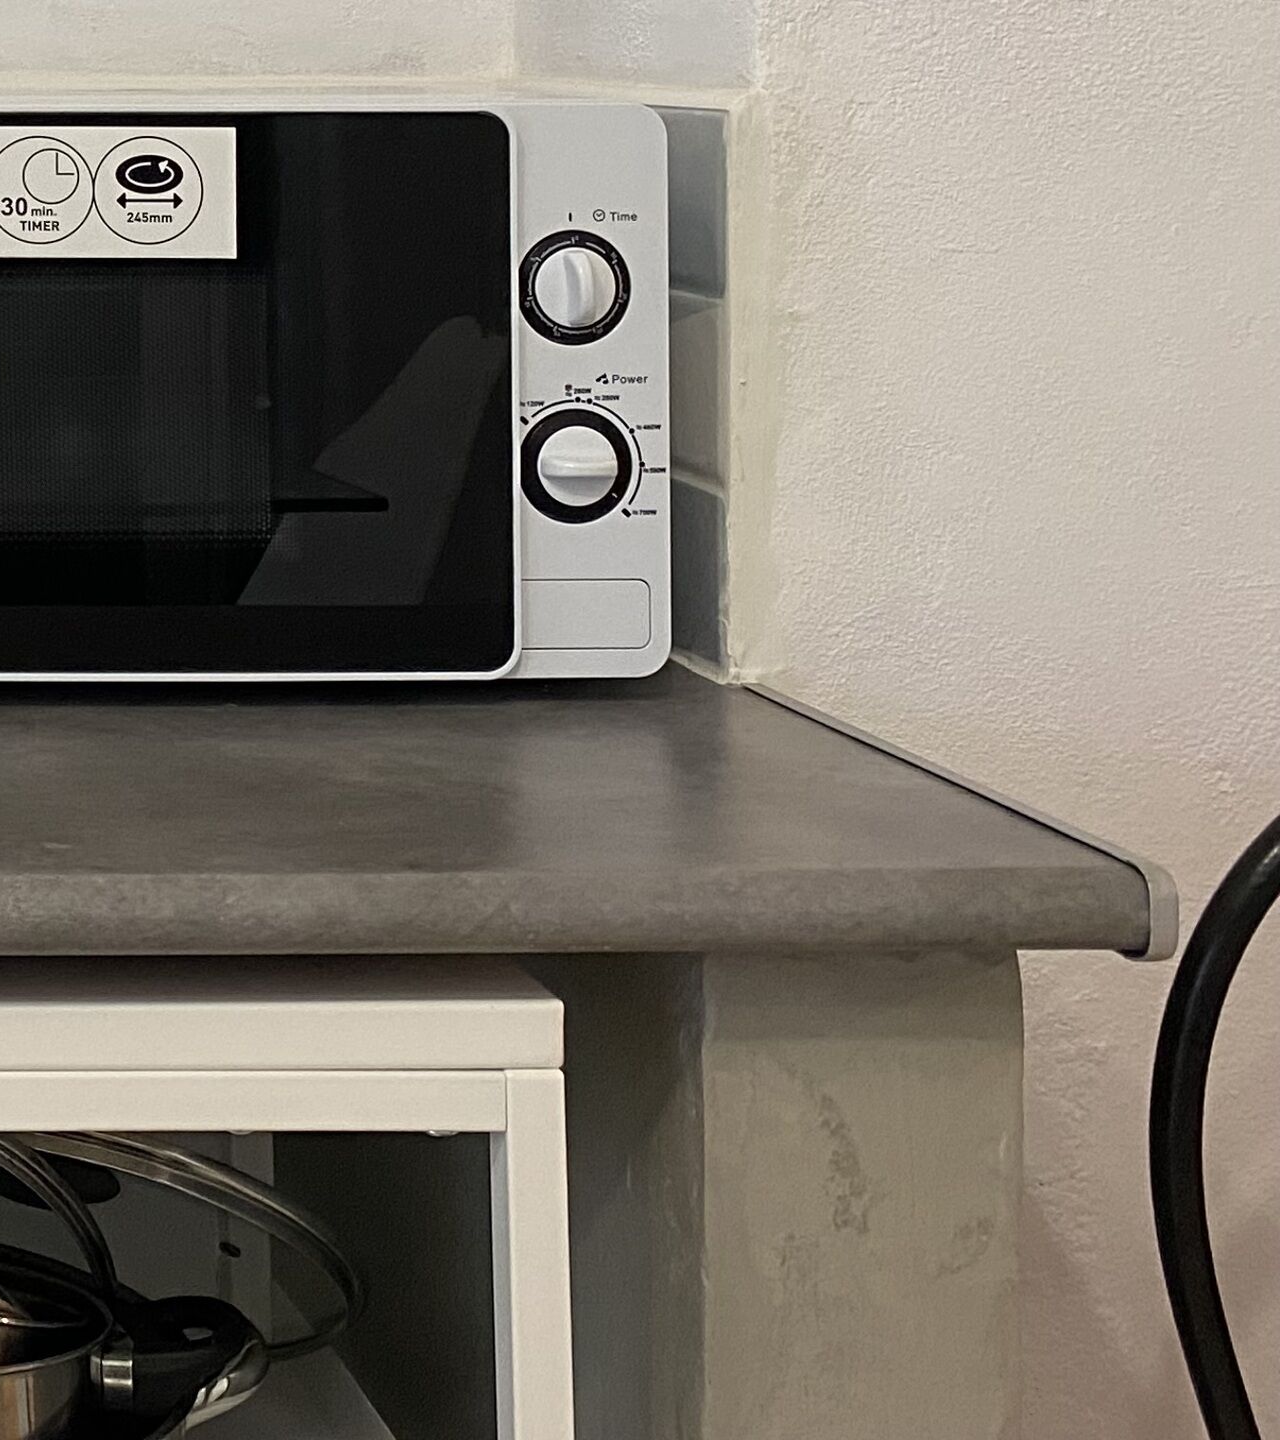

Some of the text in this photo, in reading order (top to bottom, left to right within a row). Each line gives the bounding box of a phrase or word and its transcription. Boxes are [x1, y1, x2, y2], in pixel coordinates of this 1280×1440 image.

[0, 196, 58, 217] 30 min.
[126, 212, 173, 224] 245mm
[609, 211, 638, 222] Time
[20, 220, 60, 232] TIMER
[611, 374, 649, 384] Power
